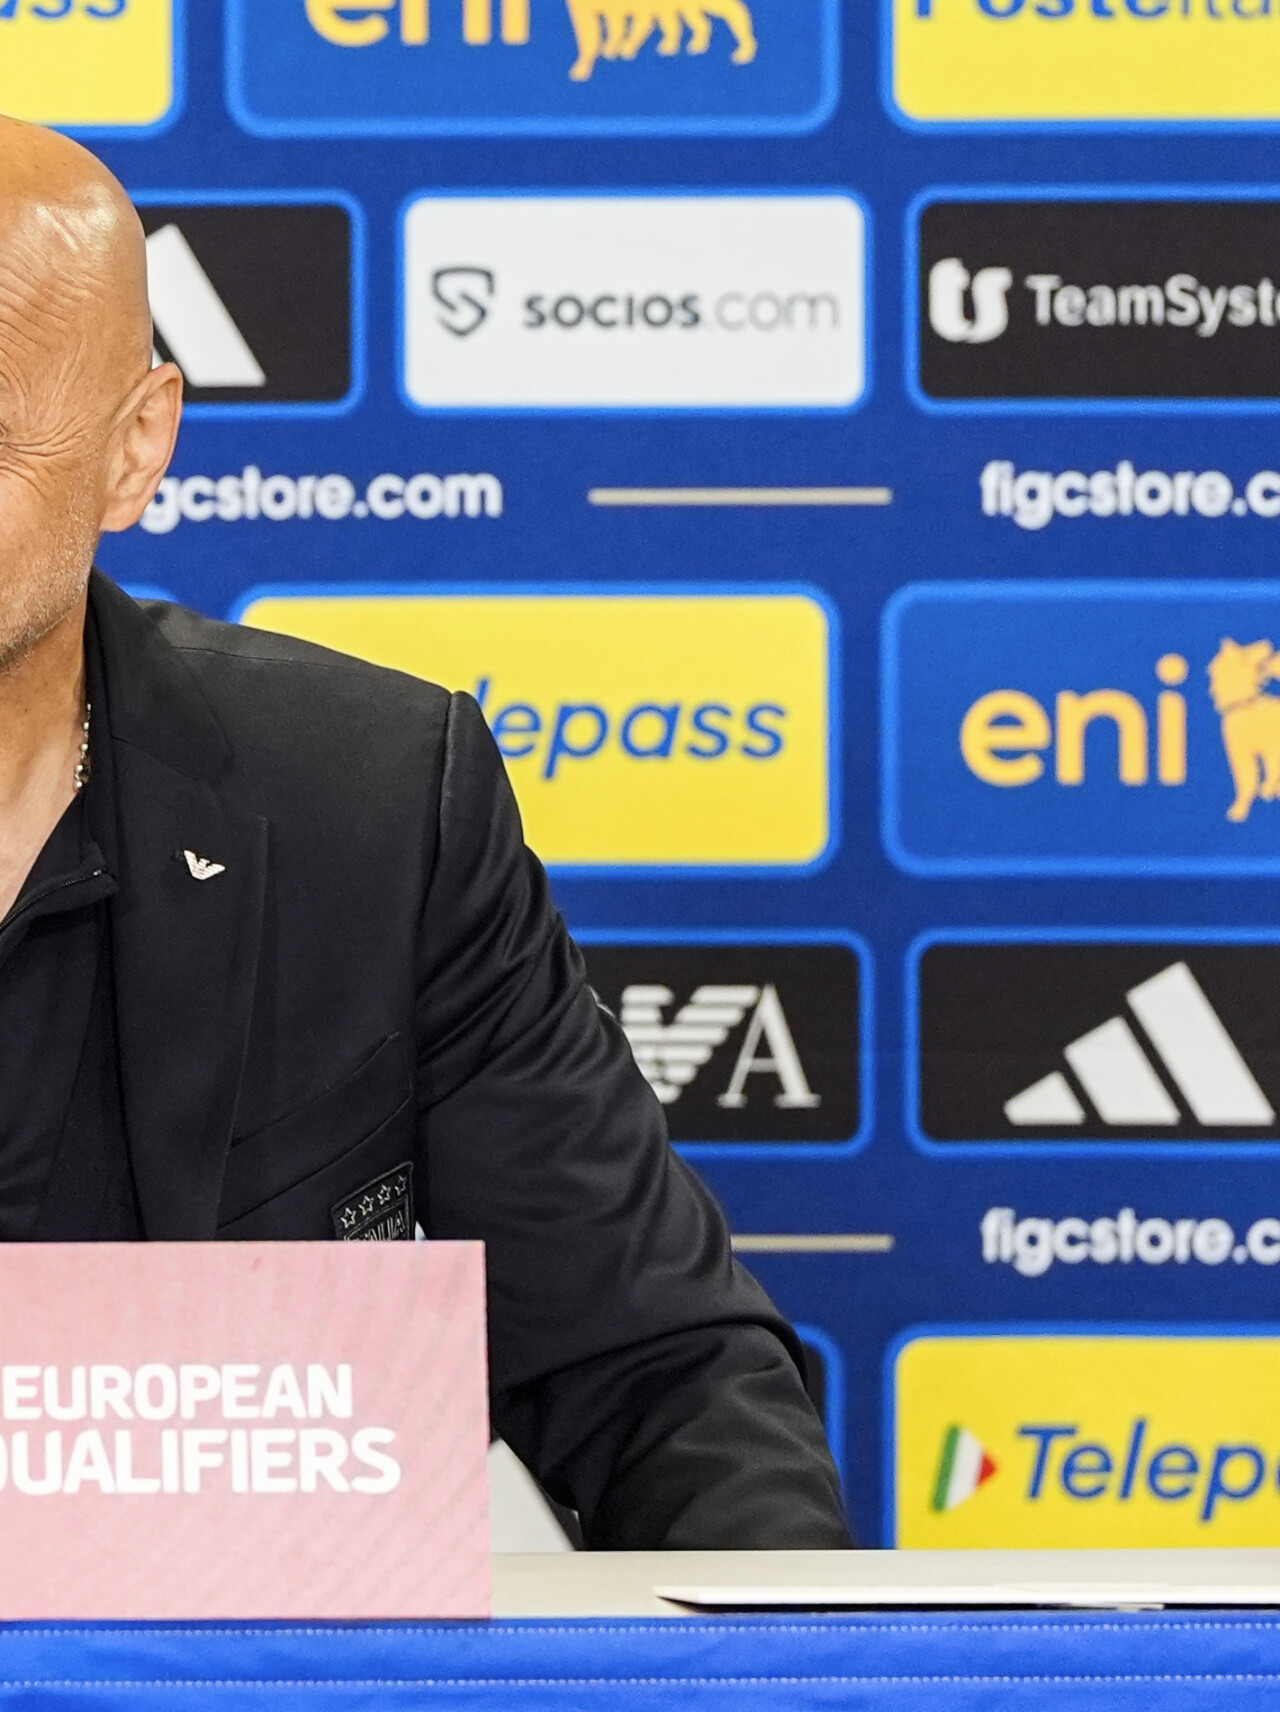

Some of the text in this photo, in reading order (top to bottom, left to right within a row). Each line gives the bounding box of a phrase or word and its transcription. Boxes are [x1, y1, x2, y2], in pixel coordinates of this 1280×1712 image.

[523, 291, 840, 332] socios.com
[1024, 272, 1280, 338] TeamSyst
[960, 652, 1187, 787] eni
[2, 1363, 354, 1421] EUROPEAN
[1019, 1418, 1280, 1522] Telep
